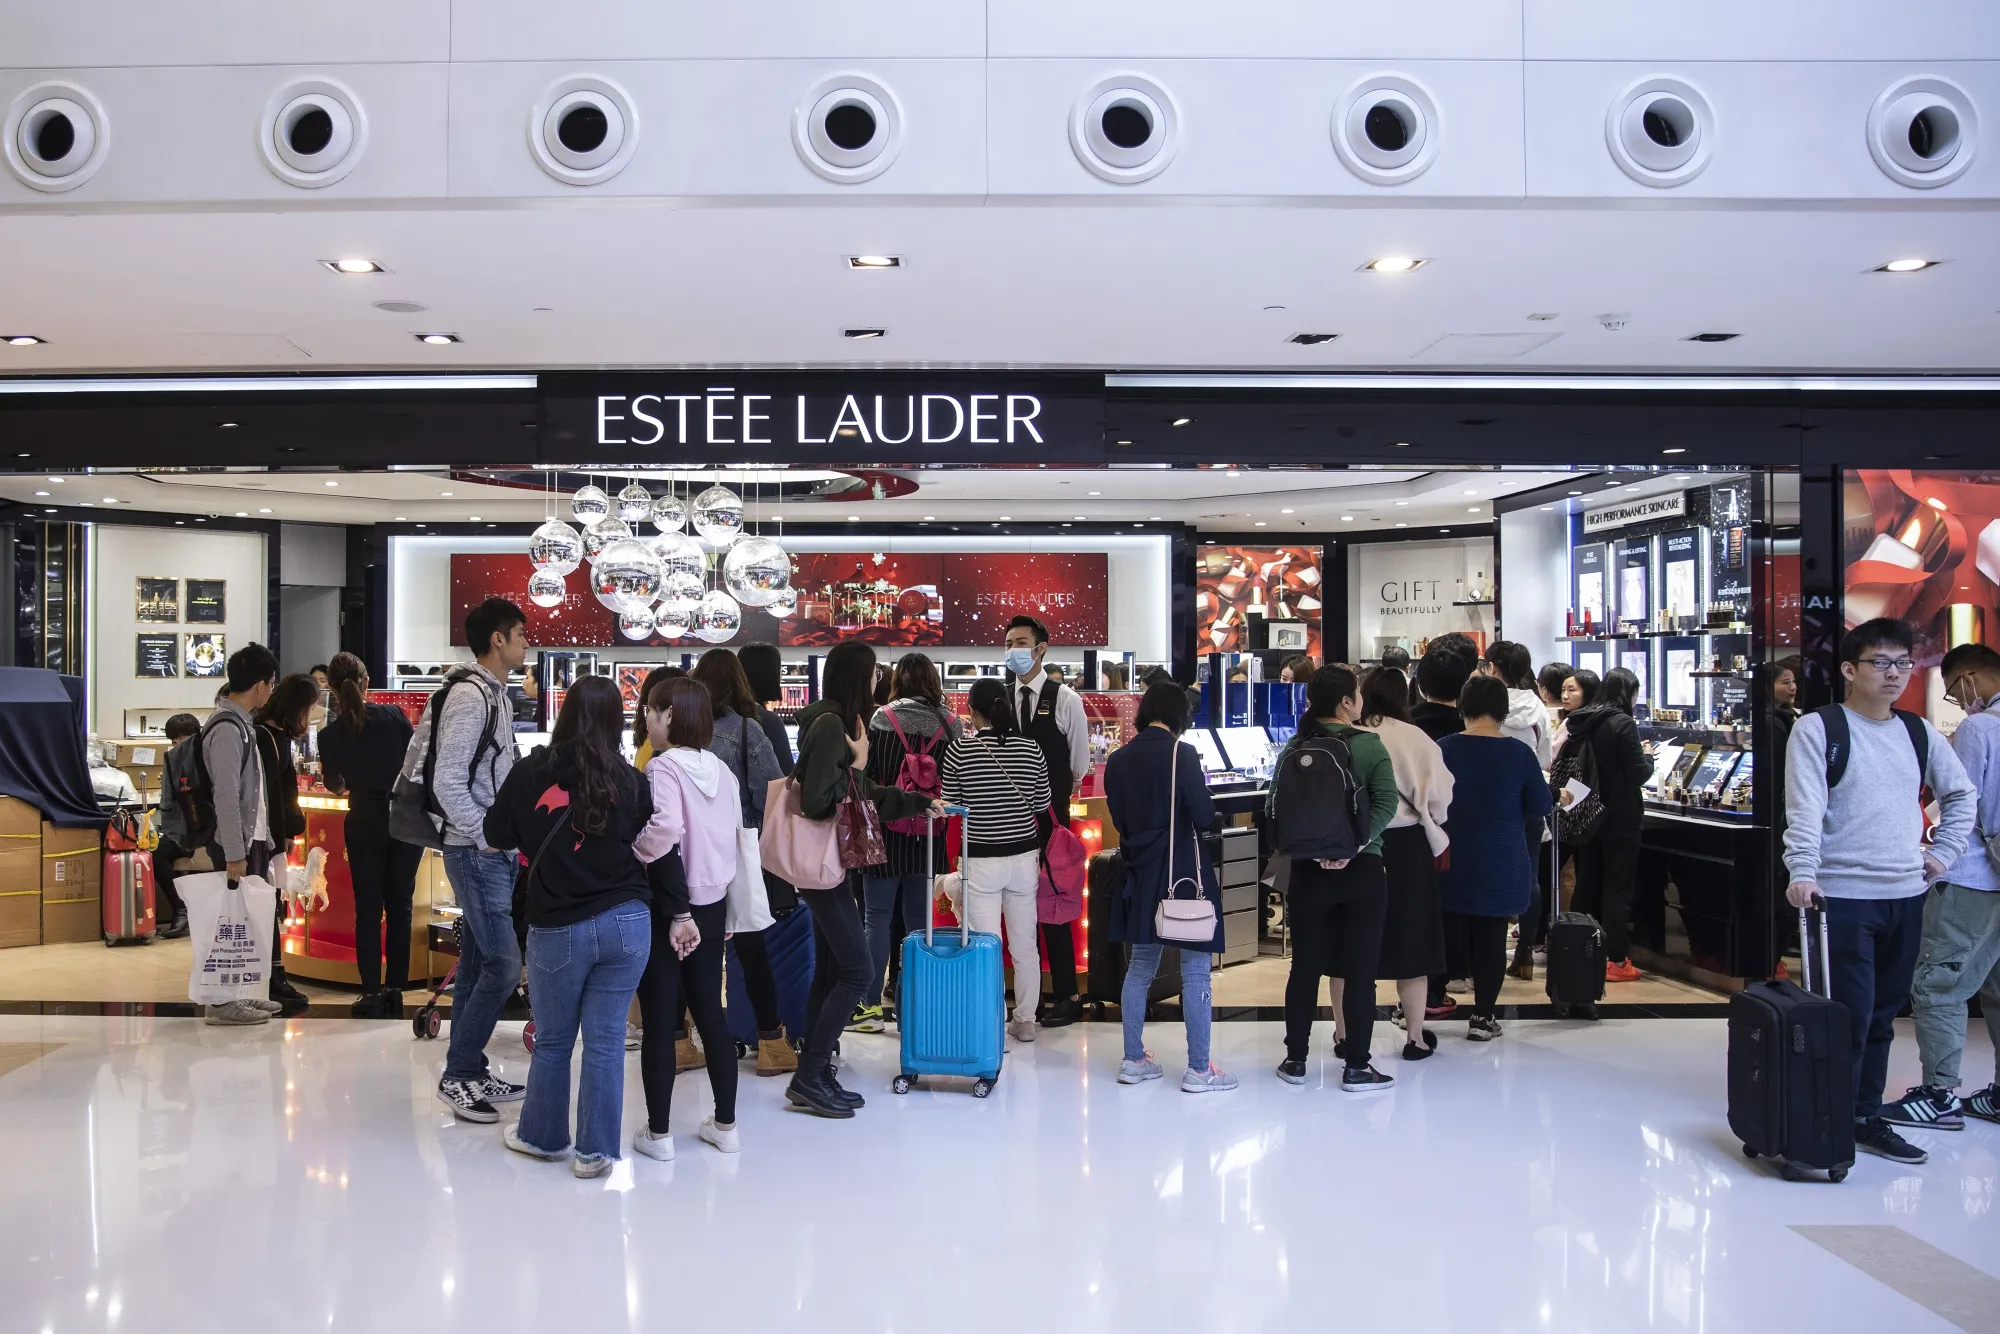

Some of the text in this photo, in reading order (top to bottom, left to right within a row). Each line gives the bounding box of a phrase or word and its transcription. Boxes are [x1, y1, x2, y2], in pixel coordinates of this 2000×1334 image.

[796, 393, 1044, 445] LAUDER
[1586, 497, 1680, 525] HIGH PERFORMANCE SKINCARE
[1021, 593, 1075, 605] LAUDER
[1381, 580, 1441, 603] GIFT
[1380, 605, 1442, 615] BEAUTIFULLY
